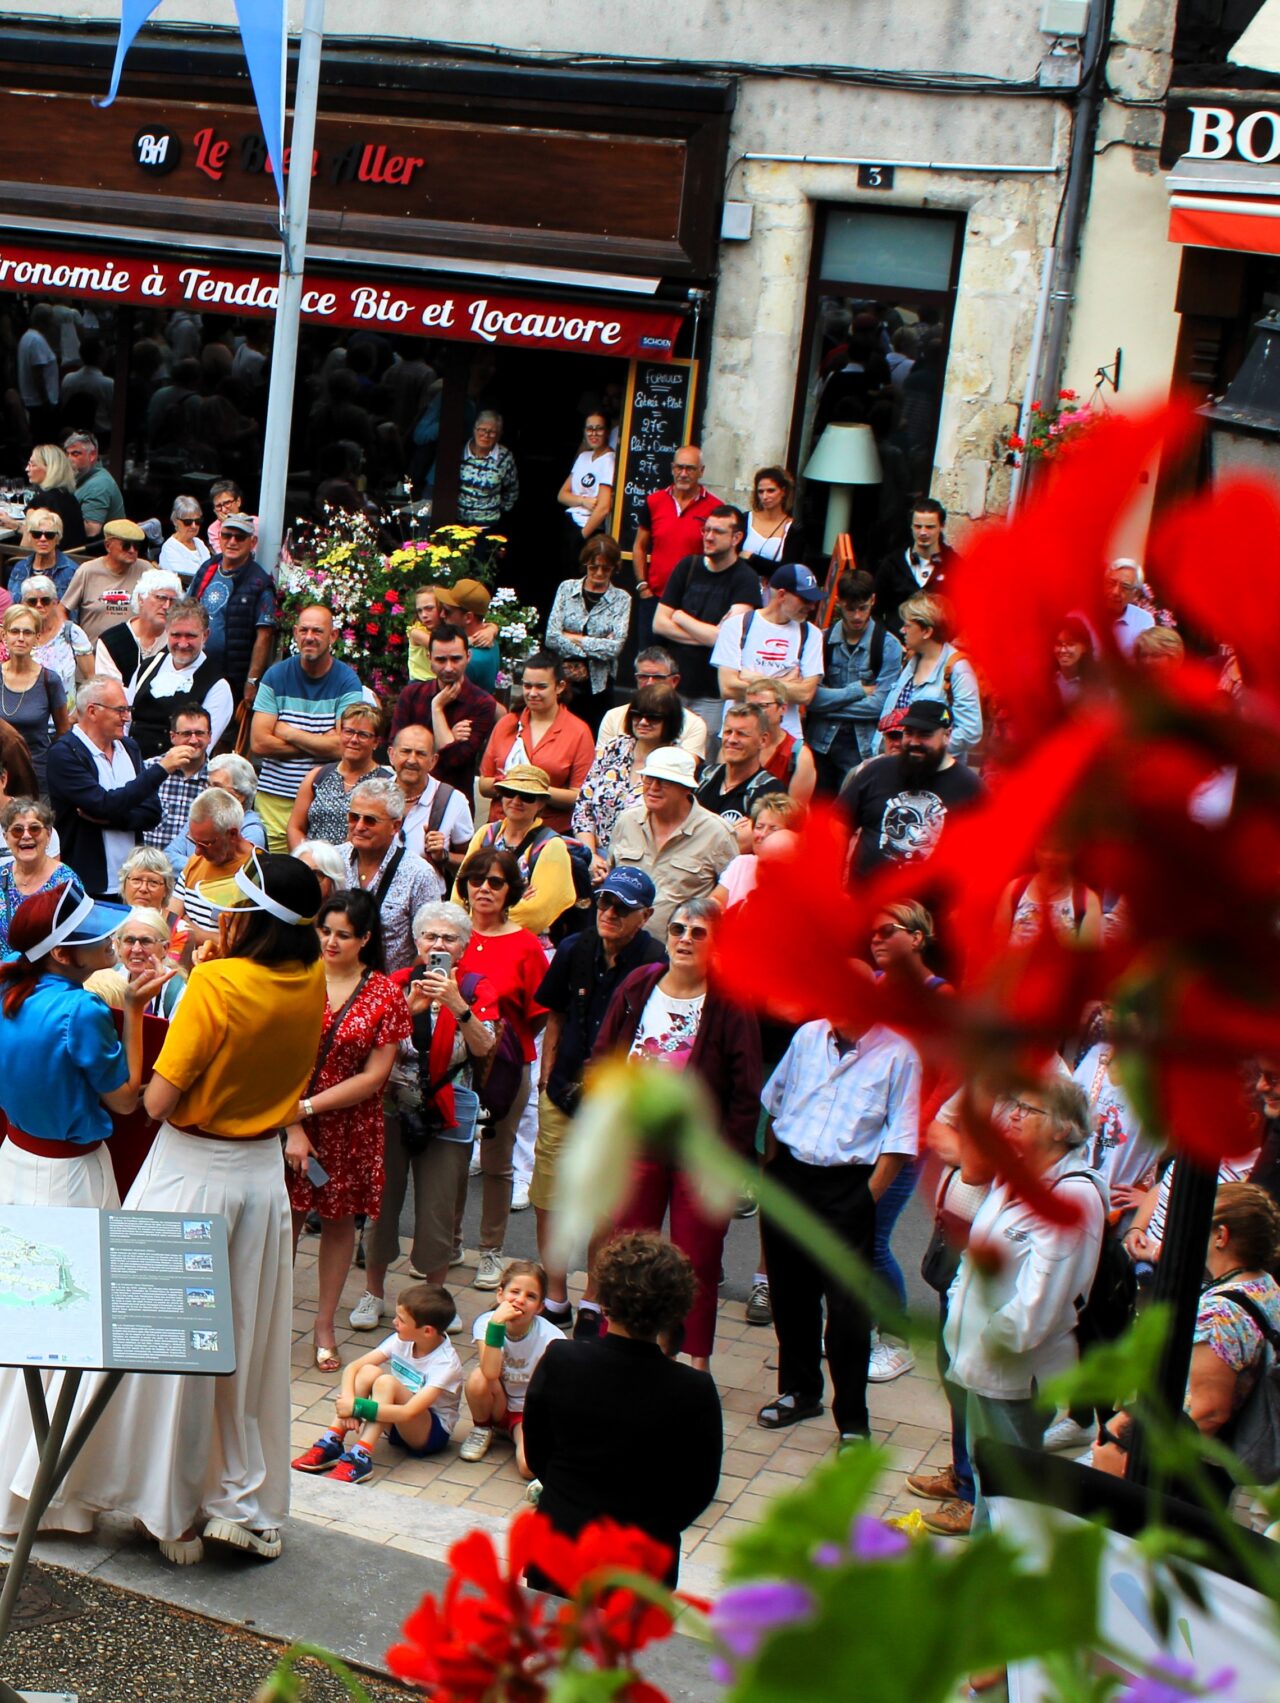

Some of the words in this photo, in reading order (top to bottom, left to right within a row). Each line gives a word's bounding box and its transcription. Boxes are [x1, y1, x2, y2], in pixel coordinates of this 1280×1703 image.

[193, 127, 230, 180] Le
[331, 140, 424, 185] Aller
[868, 167, 882, 186] 3
[140, 265, 166, 296] à
[178, 268, 337, 315] Tendace
[350, 286, 416, 322] Bio
[421, 299, 455, 327] et
[467, 299, 622, 344] Locavore
[642, 337, 672, 348] SCHOEN
[640, 418, 669, 434] 27€
[638, 459, 661, 476] 27€
